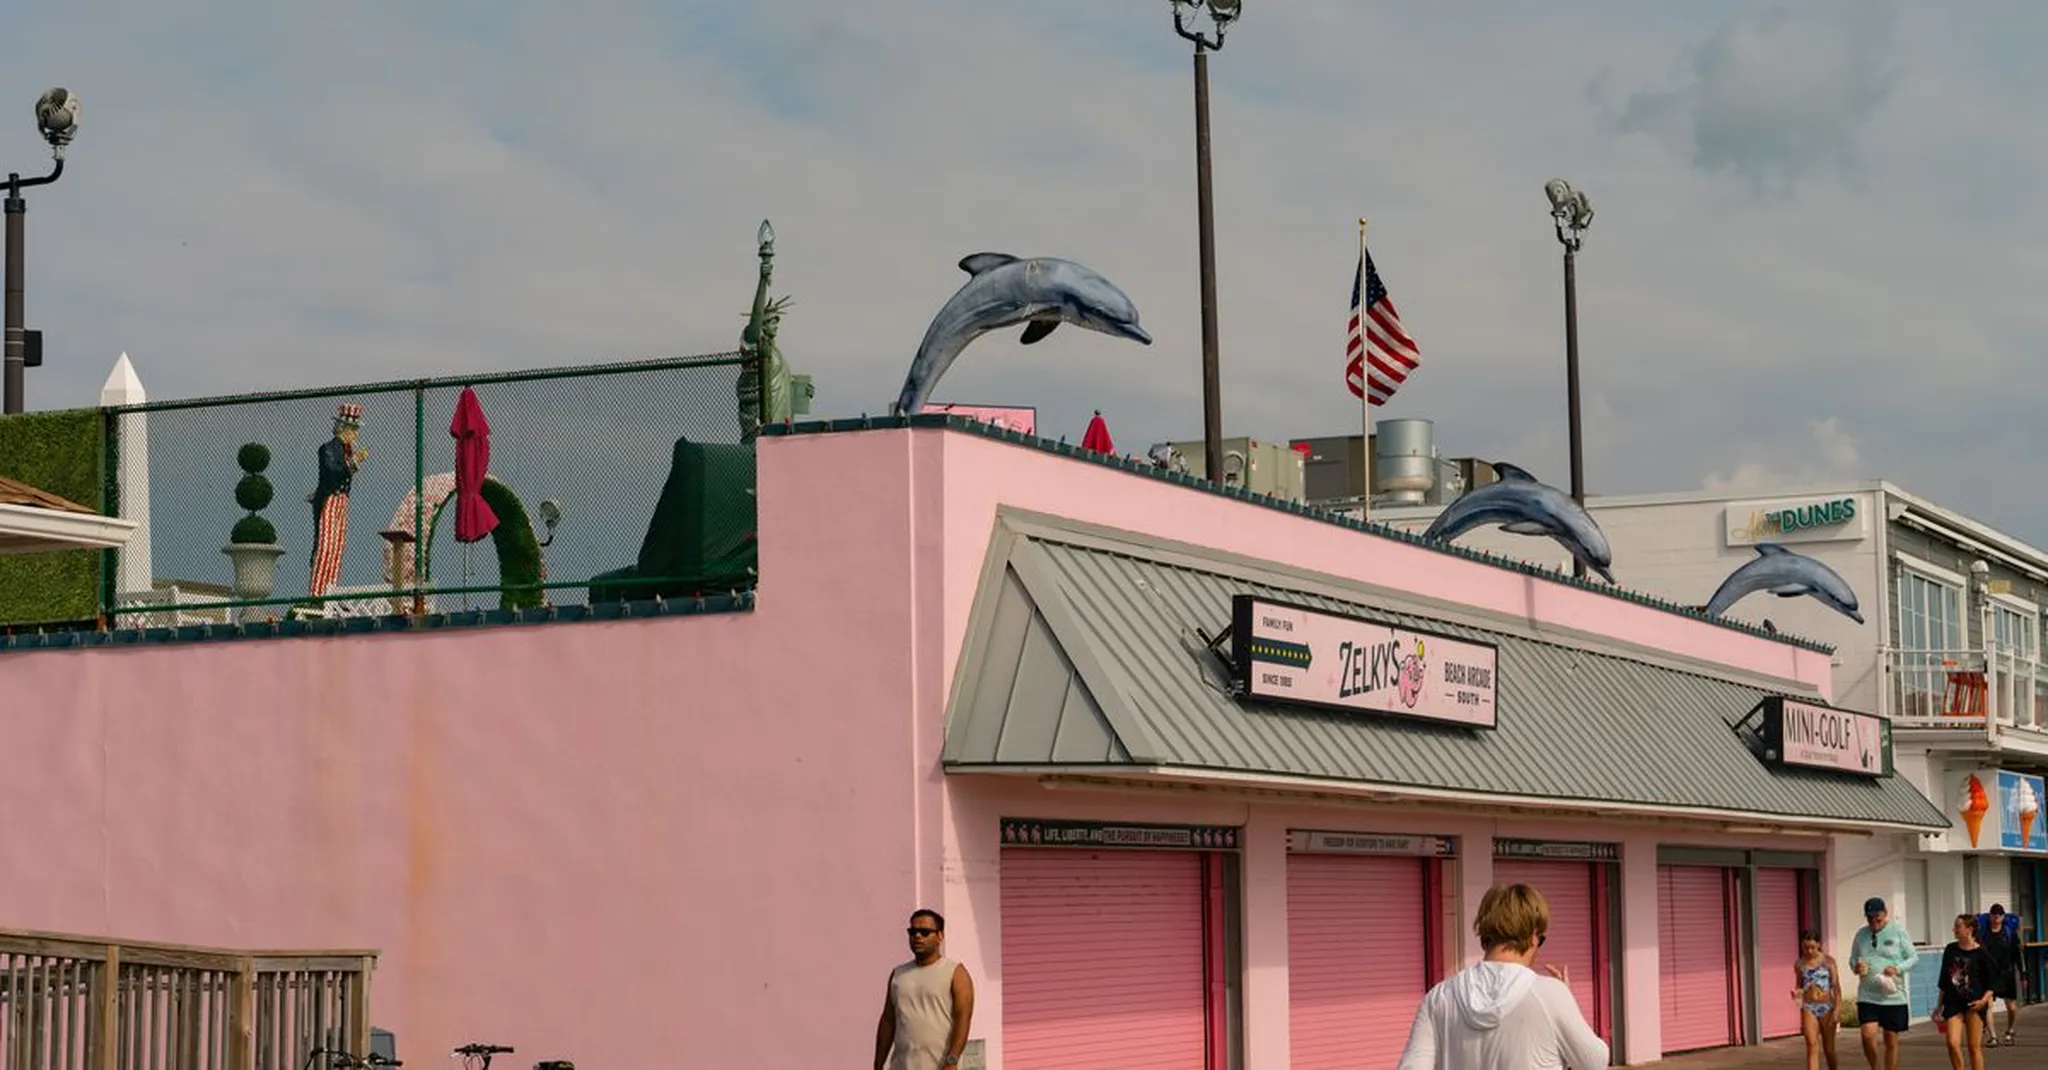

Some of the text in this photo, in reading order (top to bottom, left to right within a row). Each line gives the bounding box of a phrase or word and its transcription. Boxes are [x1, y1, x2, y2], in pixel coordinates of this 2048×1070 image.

[1781, 498, 1855, 533] DUNES
[1262, 616, 1293, 632] FAMILY FUN
[1262, 673, 1278, 685] SINCE
[1444, 661, 1491, 690] BEACH ARCADE
[1457, 690, 1480, 706] SOUTH
[1786, 707, 1850, 750] MINI-GOLF
[1044, 827, 1060, 841] LIFE,
[1090, 829, 1103, 841] AND
[1104, 830, 1115, 842] THE
[1118, 830, 1142, 842] PURSUIT
[1143, 830, 1151, 842] OF
